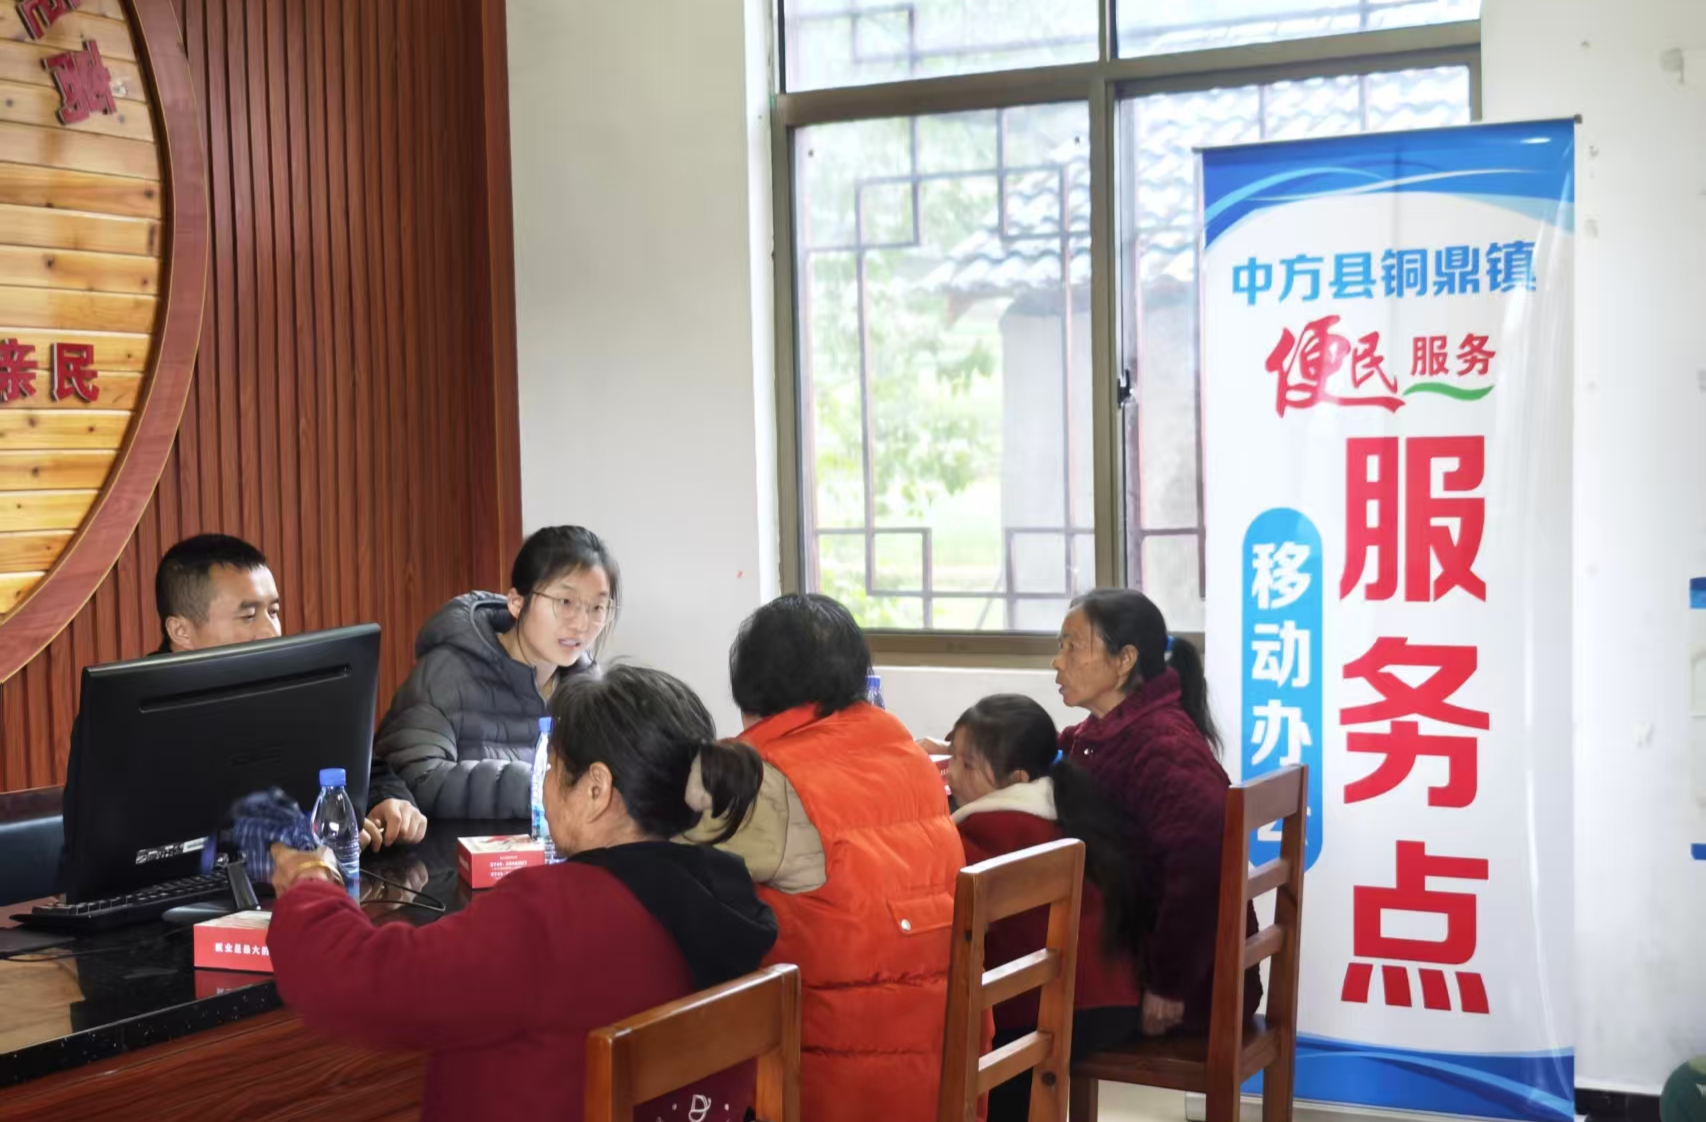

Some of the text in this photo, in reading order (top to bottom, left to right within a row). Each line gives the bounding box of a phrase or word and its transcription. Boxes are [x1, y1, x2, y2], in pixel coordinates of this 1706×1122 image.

[1231, 240, 1537, 306] 中方县铜鼎镇
[0, 338, 100, 402] 亲民
[1339, 435, 1490, 1015] 服务点
